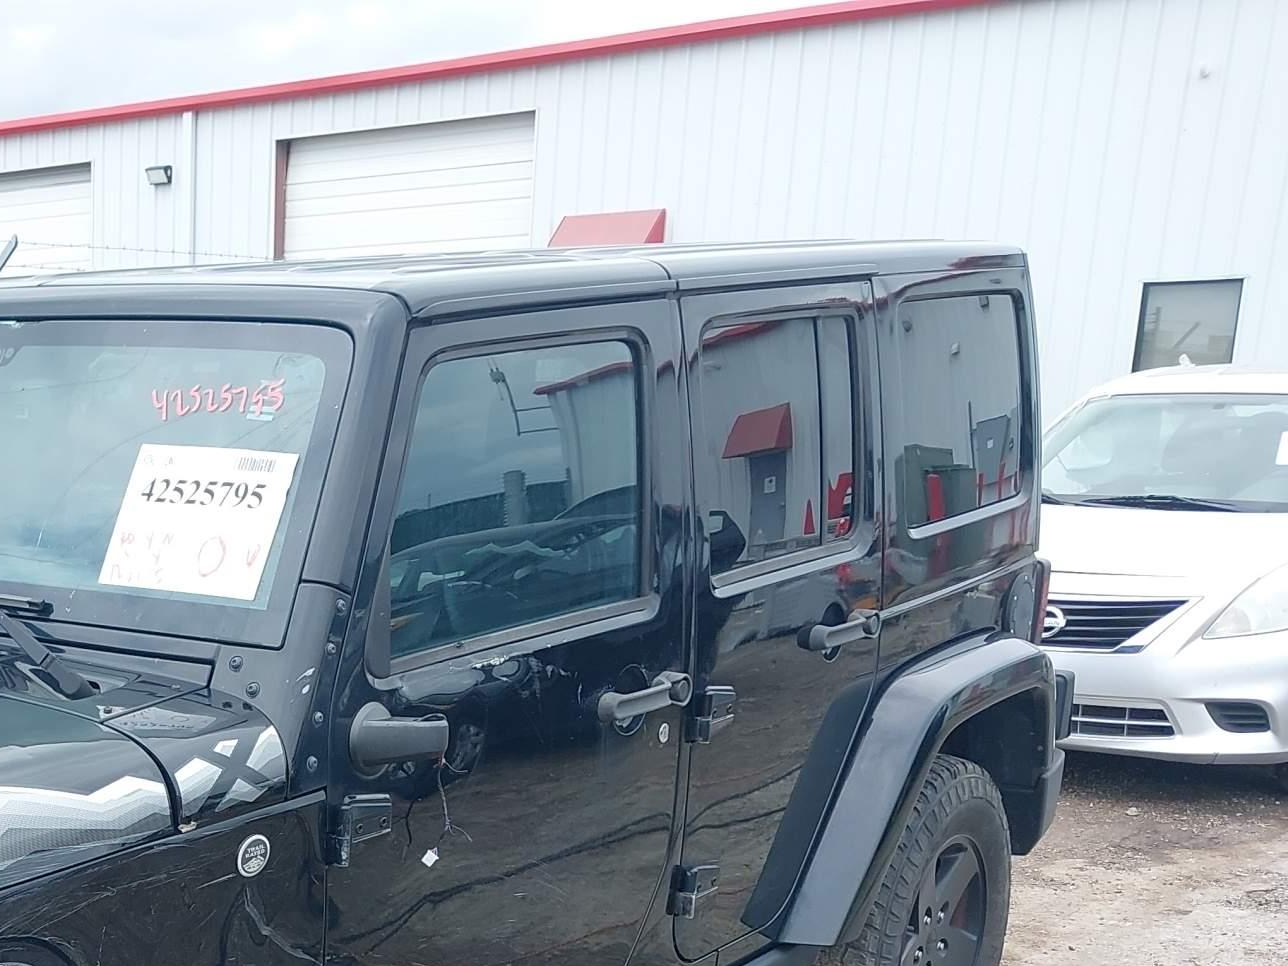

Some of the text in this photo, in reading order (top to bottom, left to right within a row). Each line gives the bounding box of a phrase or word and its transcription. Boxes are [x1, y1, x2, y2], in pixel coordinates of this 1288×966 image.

[140, 478, 268, 509] 42525795
[245, 849, 265, 858] RATED
[247, 844, 265, 854] TRAIL
